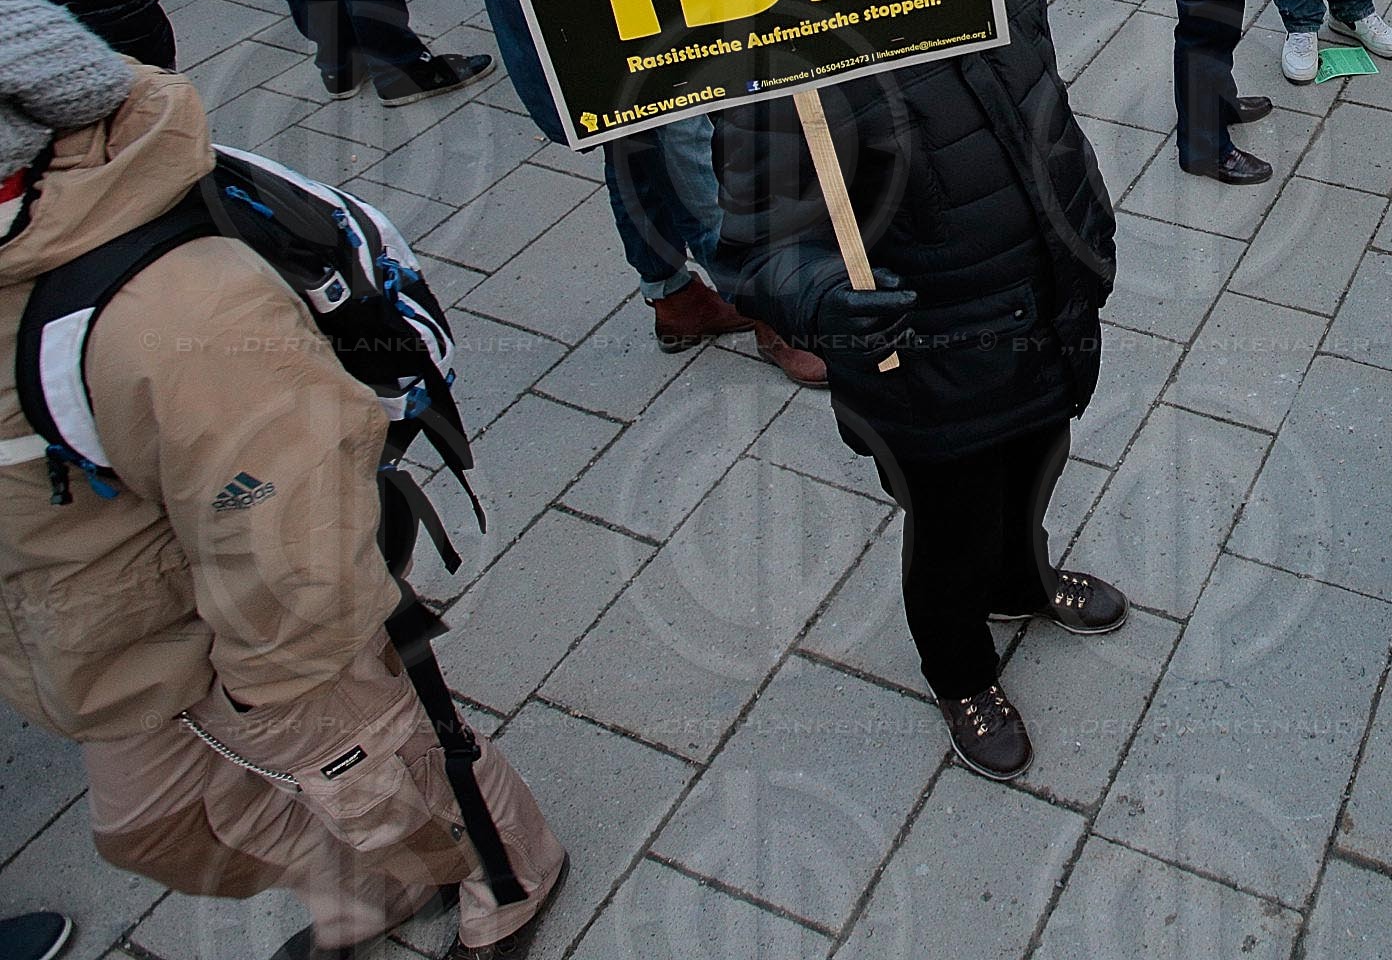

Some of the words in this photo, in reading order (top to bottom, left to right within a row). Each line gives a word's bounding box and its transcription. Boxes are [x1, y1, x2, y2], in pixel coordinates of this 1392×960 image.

[626, 39, 741, 74] Rassistische
[747, 11, 860, 48] Aufmärsche
[761, 71, 809, 88] /linkswende
[815, 54, 870, 75] 06504522473
[876, 30, 987, 59] linkswende@linkswende.org
[602, 84, 727, 128] Linkswende
[211, 482, 275, 512] adidas
